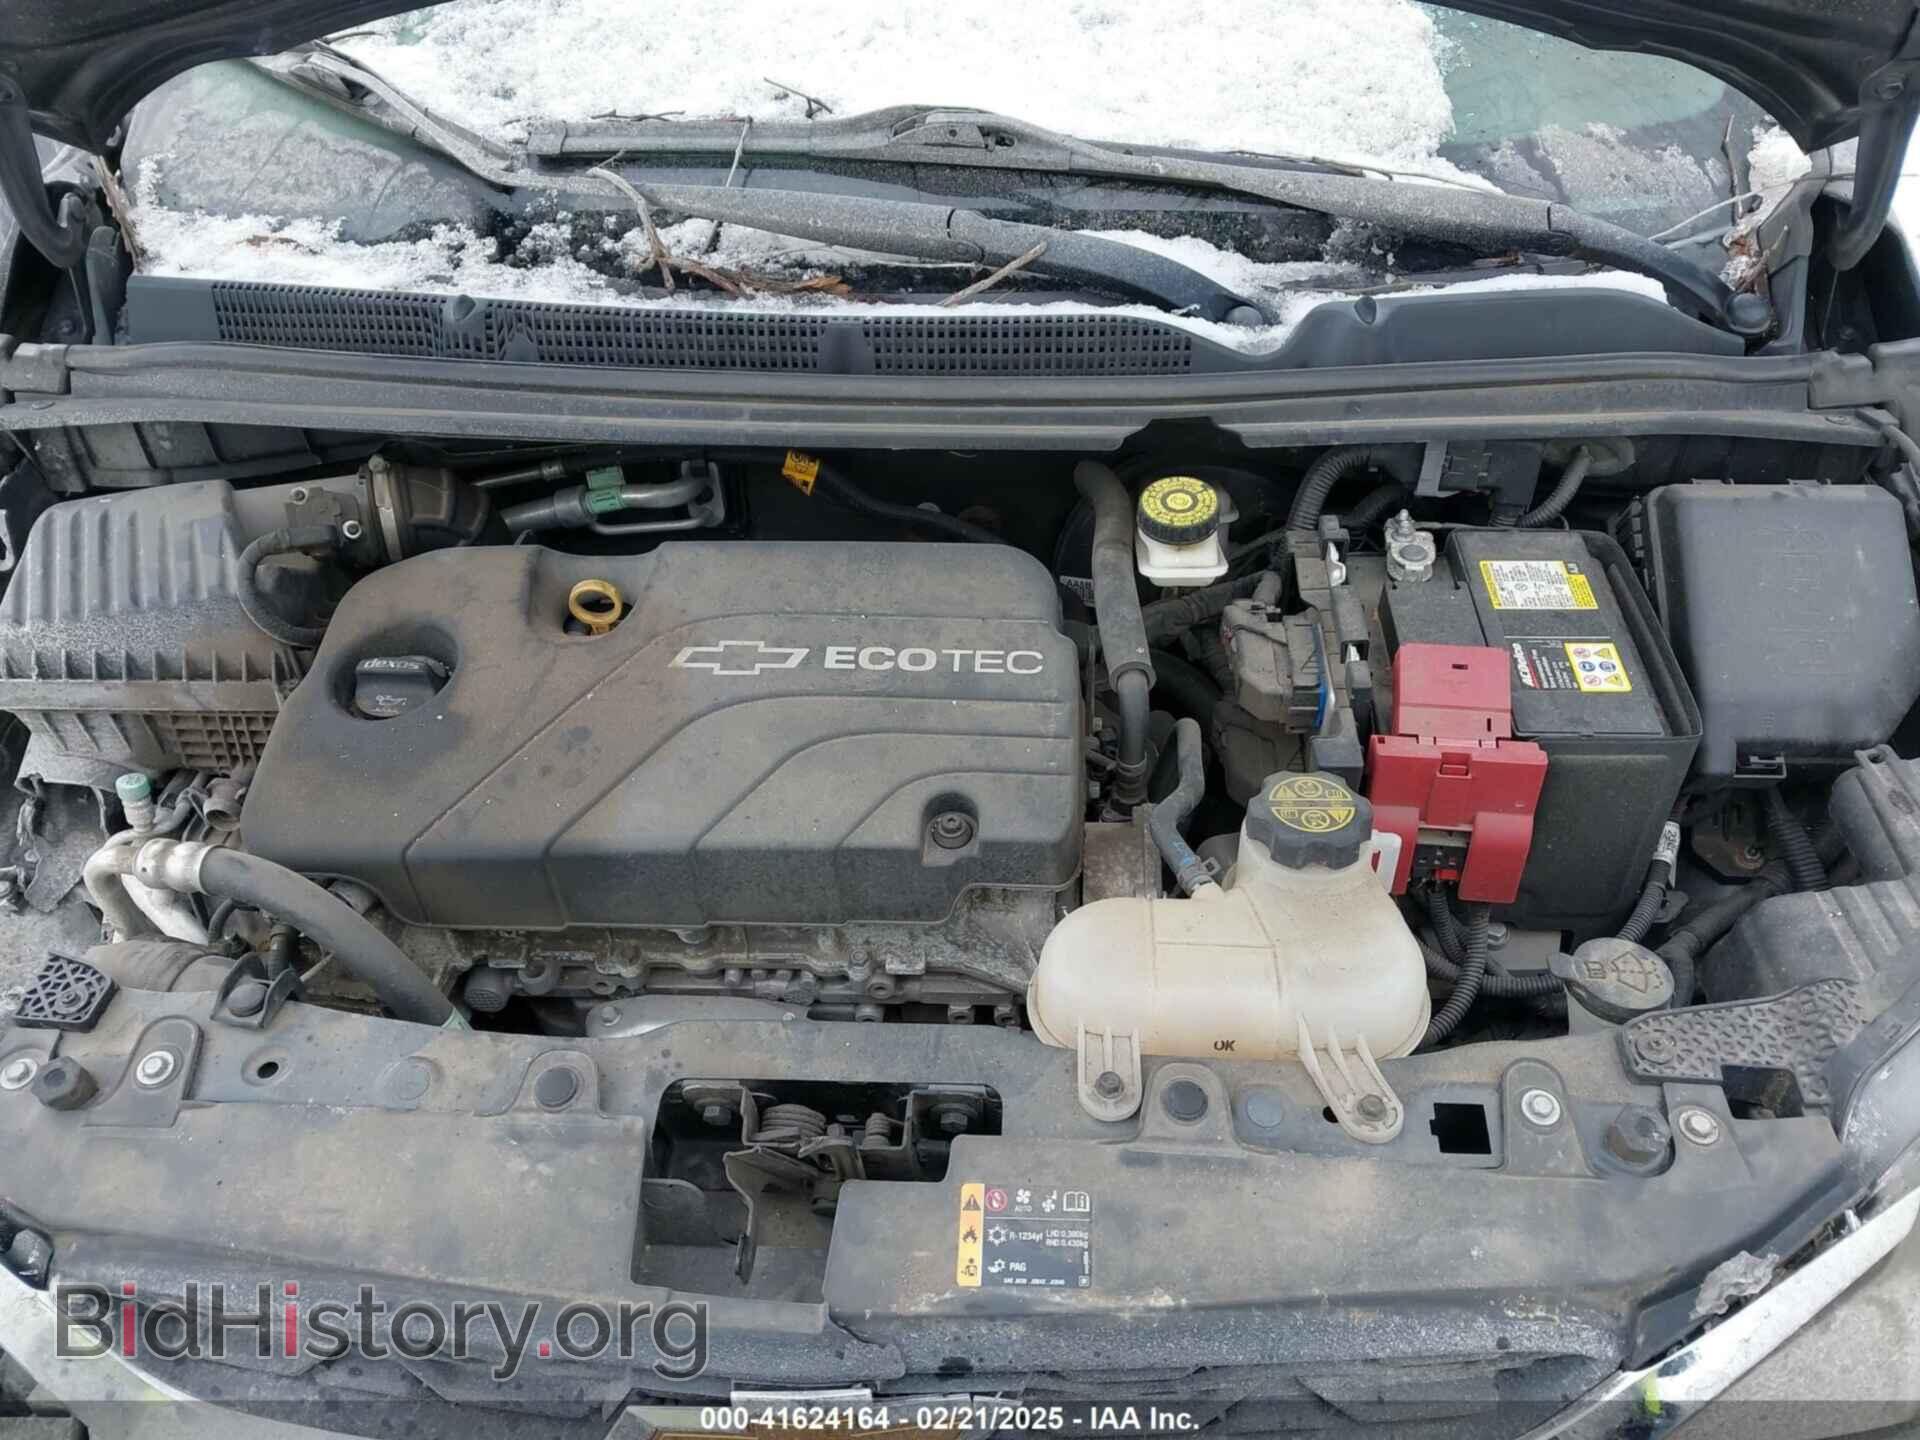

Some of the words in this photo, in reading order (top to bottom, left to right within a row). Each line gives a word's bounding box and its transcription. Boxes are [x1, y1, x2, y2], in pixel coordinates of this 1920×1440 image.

[823, 646, 1044, 674] ECOTEC
[1511, 642, 1536, 688] ACDelco
[1213, 1039, 1236, 1052] OK
[1009, 1262, 1027, 1272] PAG
